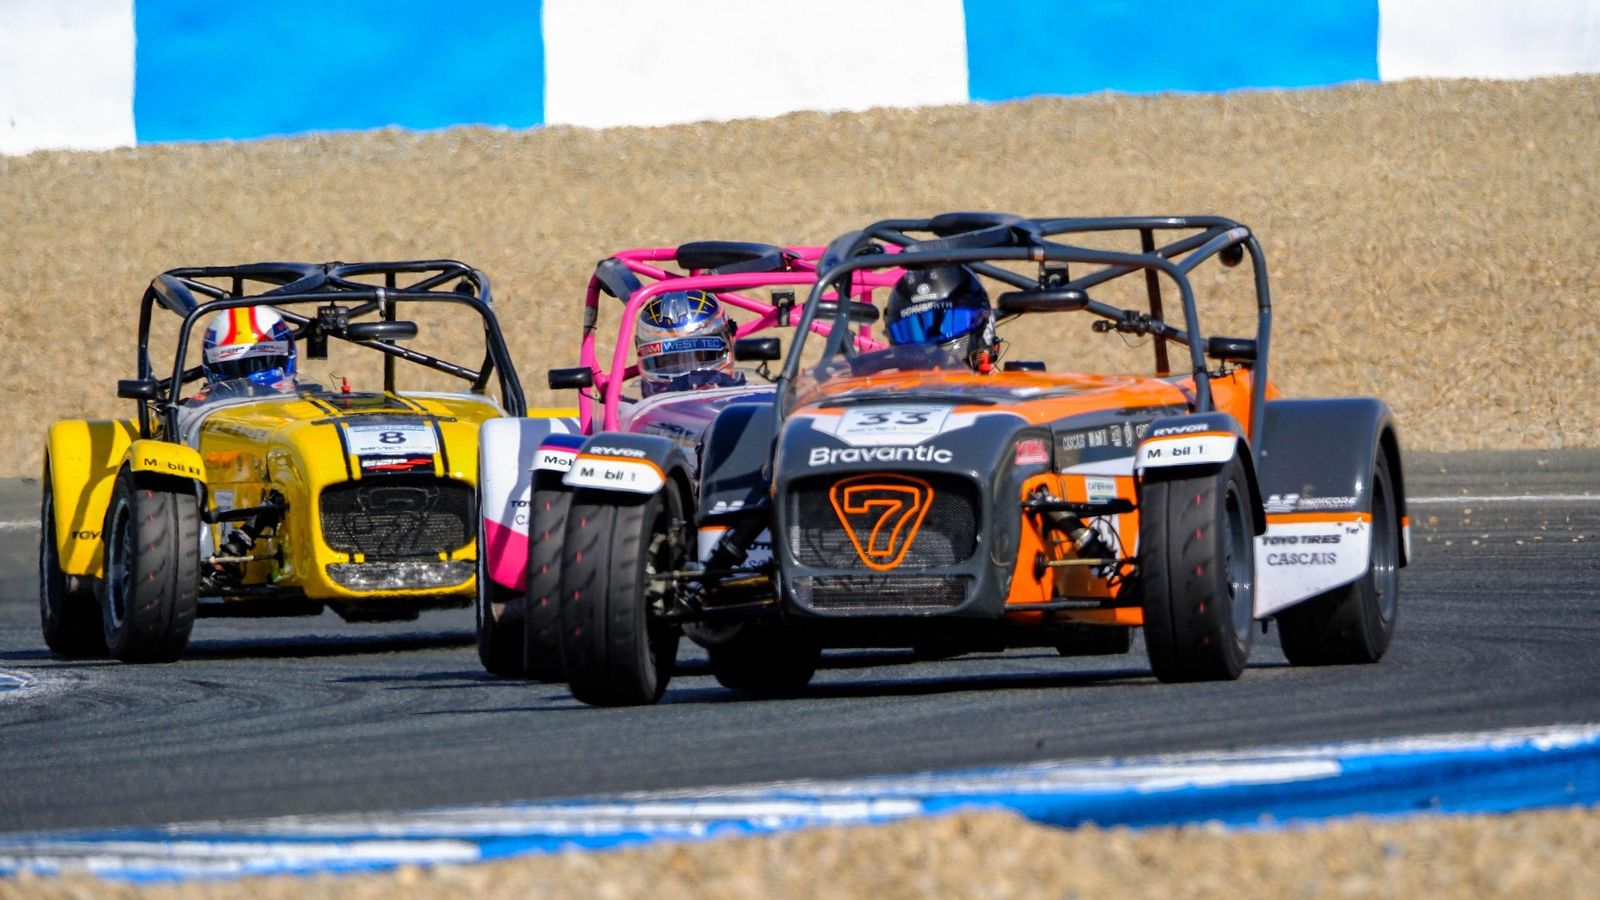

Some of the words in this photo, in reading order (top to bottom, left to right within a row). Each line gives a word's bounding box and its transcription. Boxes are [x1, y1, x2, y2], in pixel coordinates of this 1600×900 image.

[663, 340, 698, 351] WEST
[856, 411, 931, 426] 33
[379, 431, 407, 444] 8
[808, 445, 953, 467] Bravantic
[1147, 446, 1190, 458] Mbil
[144, 457, 185, 473] Mbil
[580, 467, 624, 481] Mbil
[844, 484, 920, 557] 7
[72, 530, 102, 540] TOY
[1262, 536, 1299, 546] TOYO
[1301, 535, 1341, 545] TIRES
[1266, 552, 1337, 567] CASCAIS
